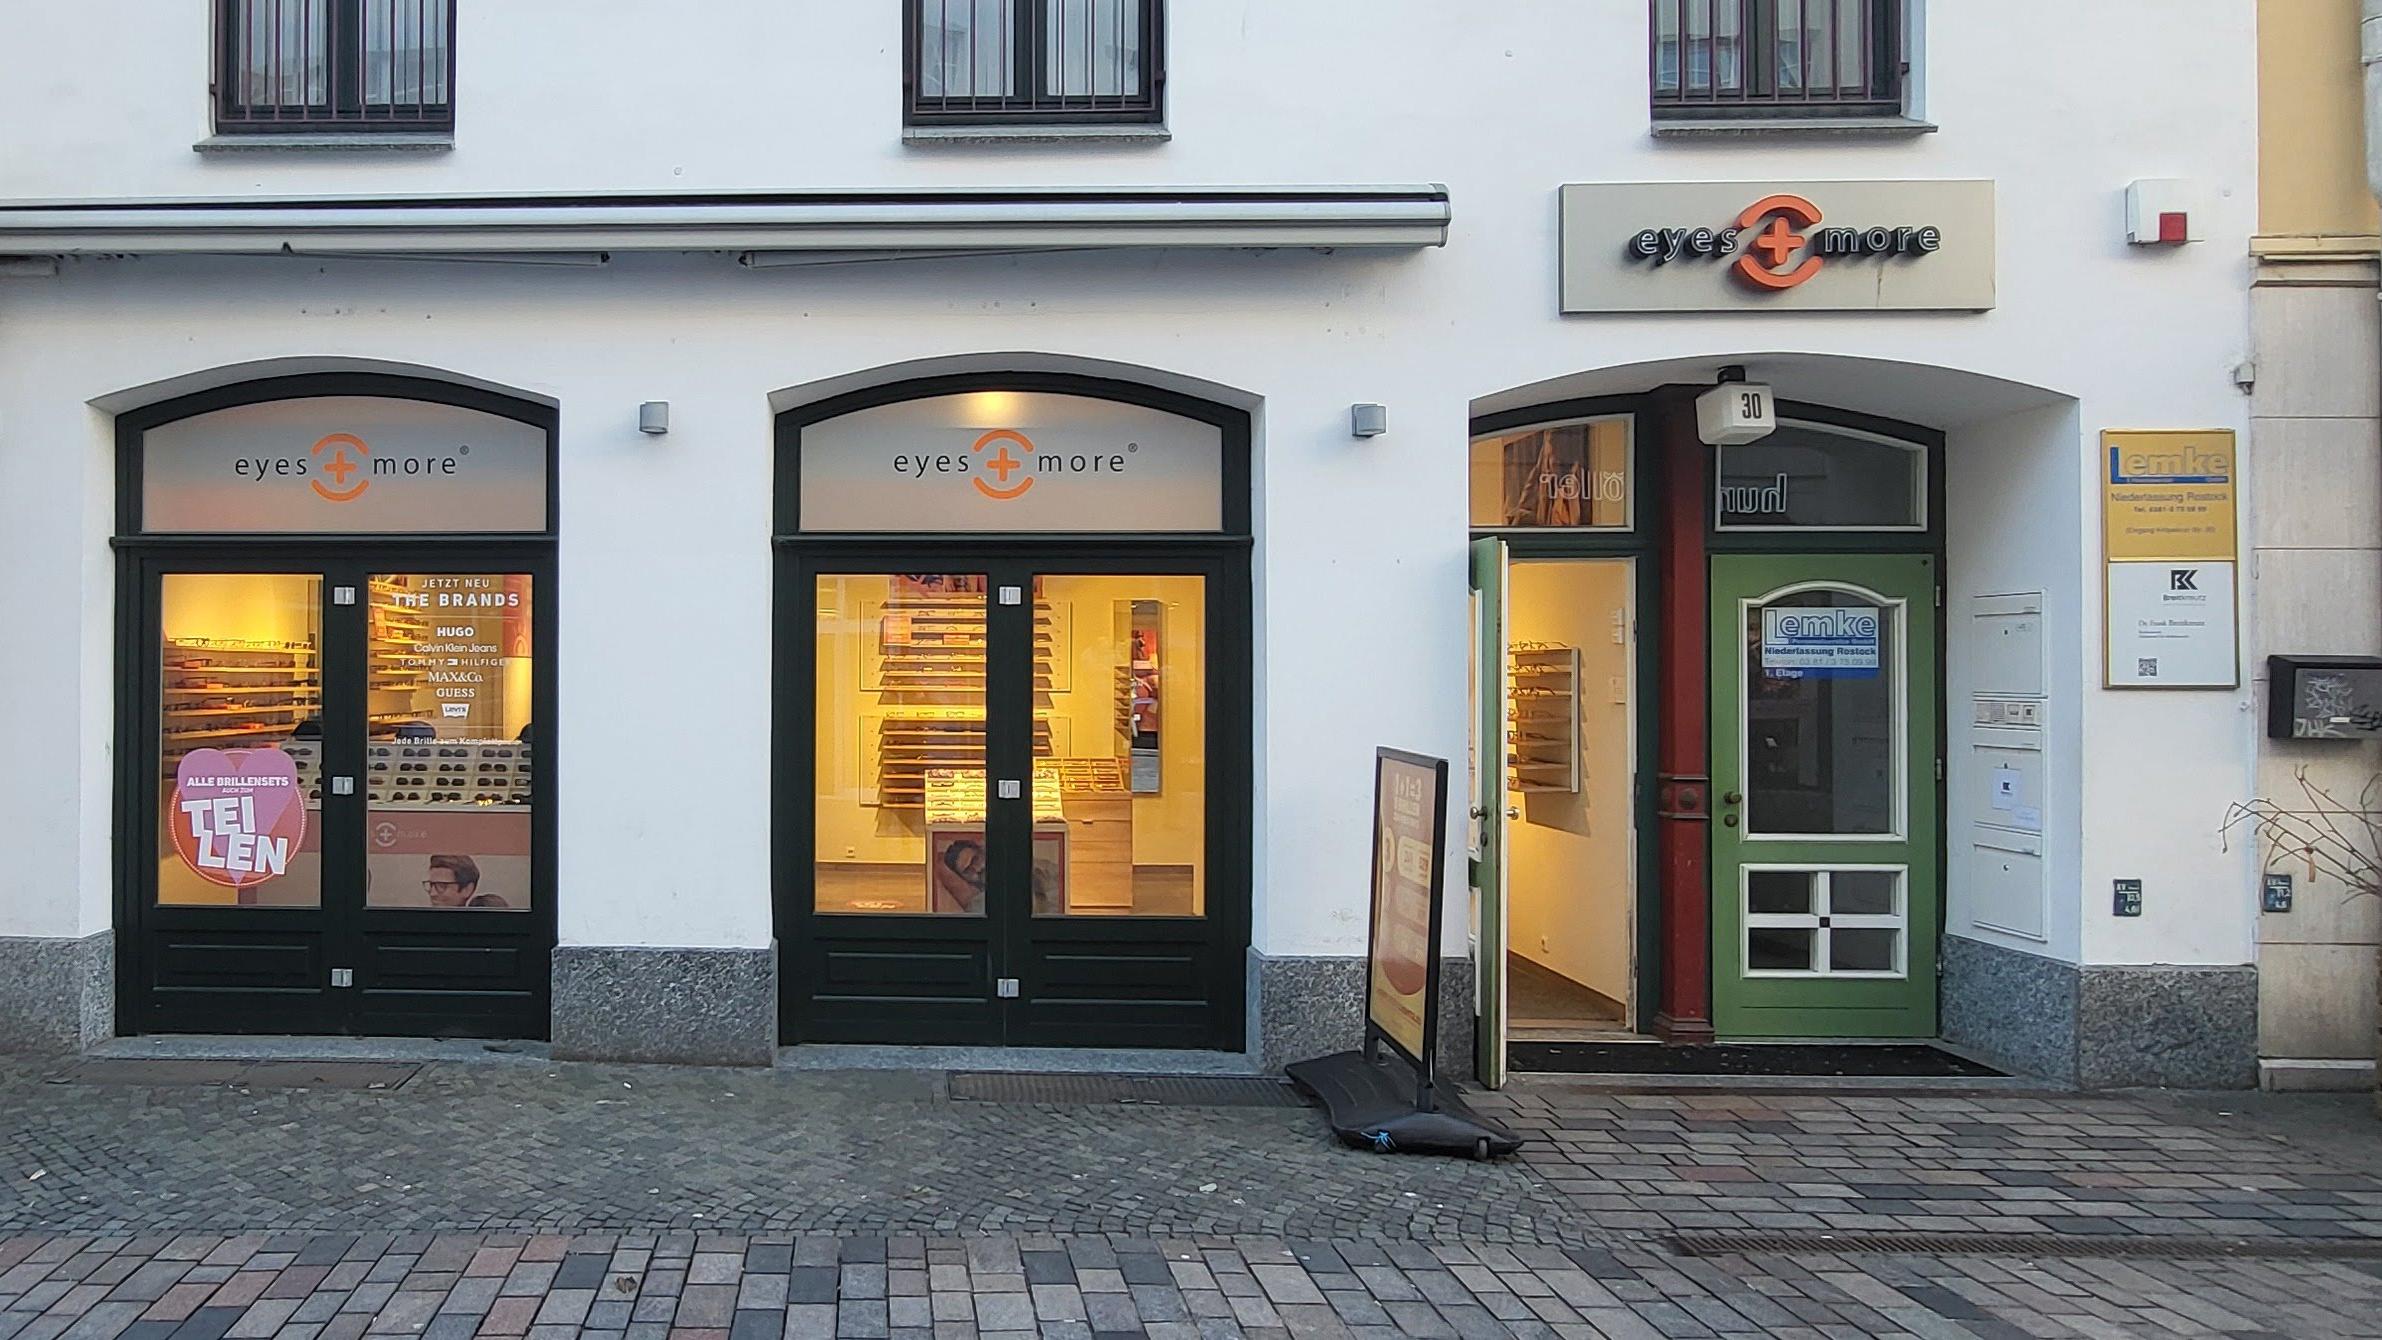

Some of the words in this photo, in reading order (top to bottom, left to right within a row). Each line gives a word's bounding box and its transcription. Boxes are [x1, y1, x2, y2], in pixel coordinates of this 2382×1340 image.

[1630, 226, 1739, 264] eyes
[1816, 226, 1942, 254] more
[1741, 392, 1762, 419] 30
[235, 457, 307, 481] eyes
[373, 457, 456, 475] more
[893, 454, 969, 478] eyes
[1038, 454, 1125, 472] more
[421, 578, 459, 588] JETZT
[465, 578, 490, 588] NEU
[392, 593, 429, 607] THE
[439, 593, 519, 607] BRANDS
[436, 626, 475, 637] HUGO
[1764, 609, 1877, 645] Lemke
[413, 643, 444, 653] Calvin
[444, 643, 468, 653] Klein
[468, 643, 497, 653] Jeans
[1764, 647, 1835, 657] Niederlassung
[1836, 647, 1877, 656] Rostock
[400, 658, 445, 666] TOMMY
[461, 658, 507, 666] HILFIGE
[436, 687, 475, 698] GUESS
[392, 736, 412, 745] Jede
[186, 776, 215, 787] ALLE
[216, 776, 289, 787] BRILLENSETS
[180, 795, 256, 838] TEI
[198, 829, 289, 875] LEN
